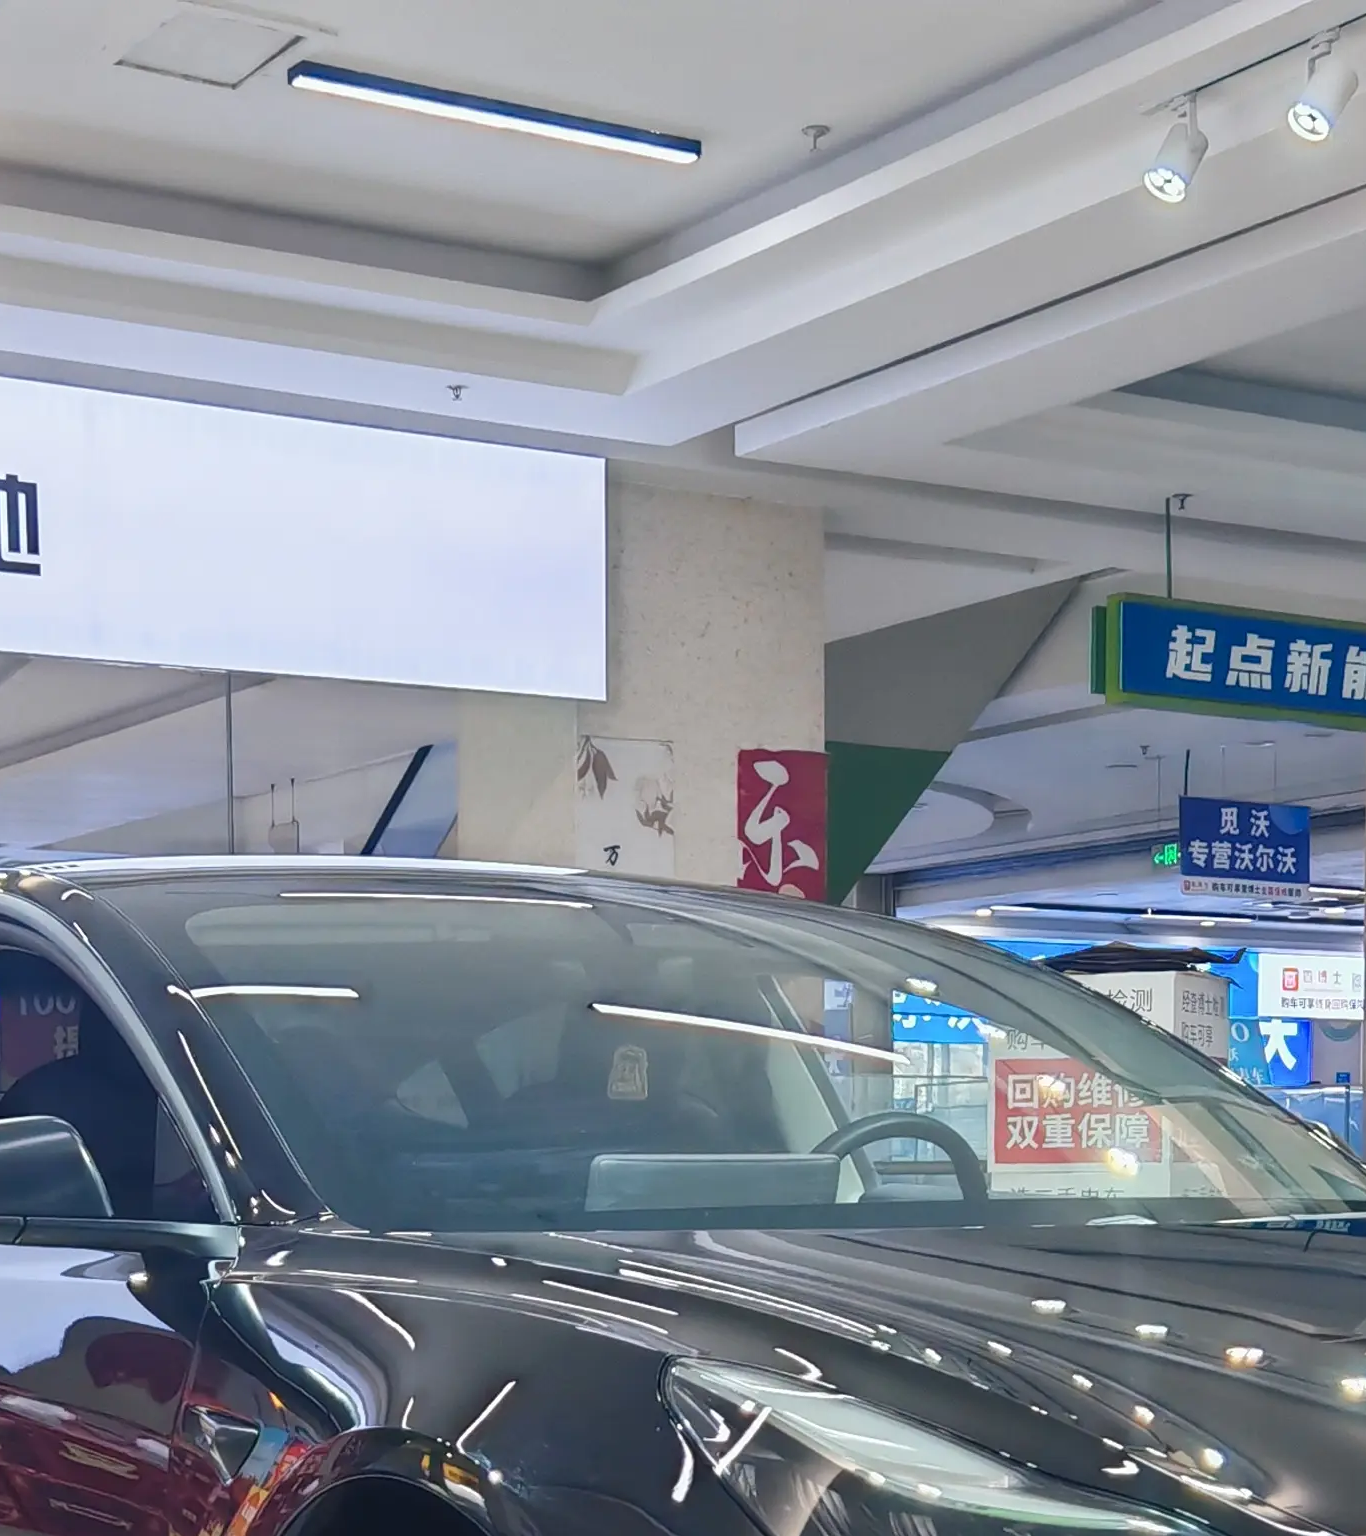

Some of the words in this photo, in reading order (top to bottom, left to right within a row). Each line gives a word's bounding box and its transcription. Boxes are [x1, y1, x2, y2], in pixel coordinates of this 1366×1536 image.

[1219, 806, 1271, 838] 觅沃
[1188, 839, 1297, 875] 专营沃尔沃
[1005, 1112, 1151, 1150] 双重保障
